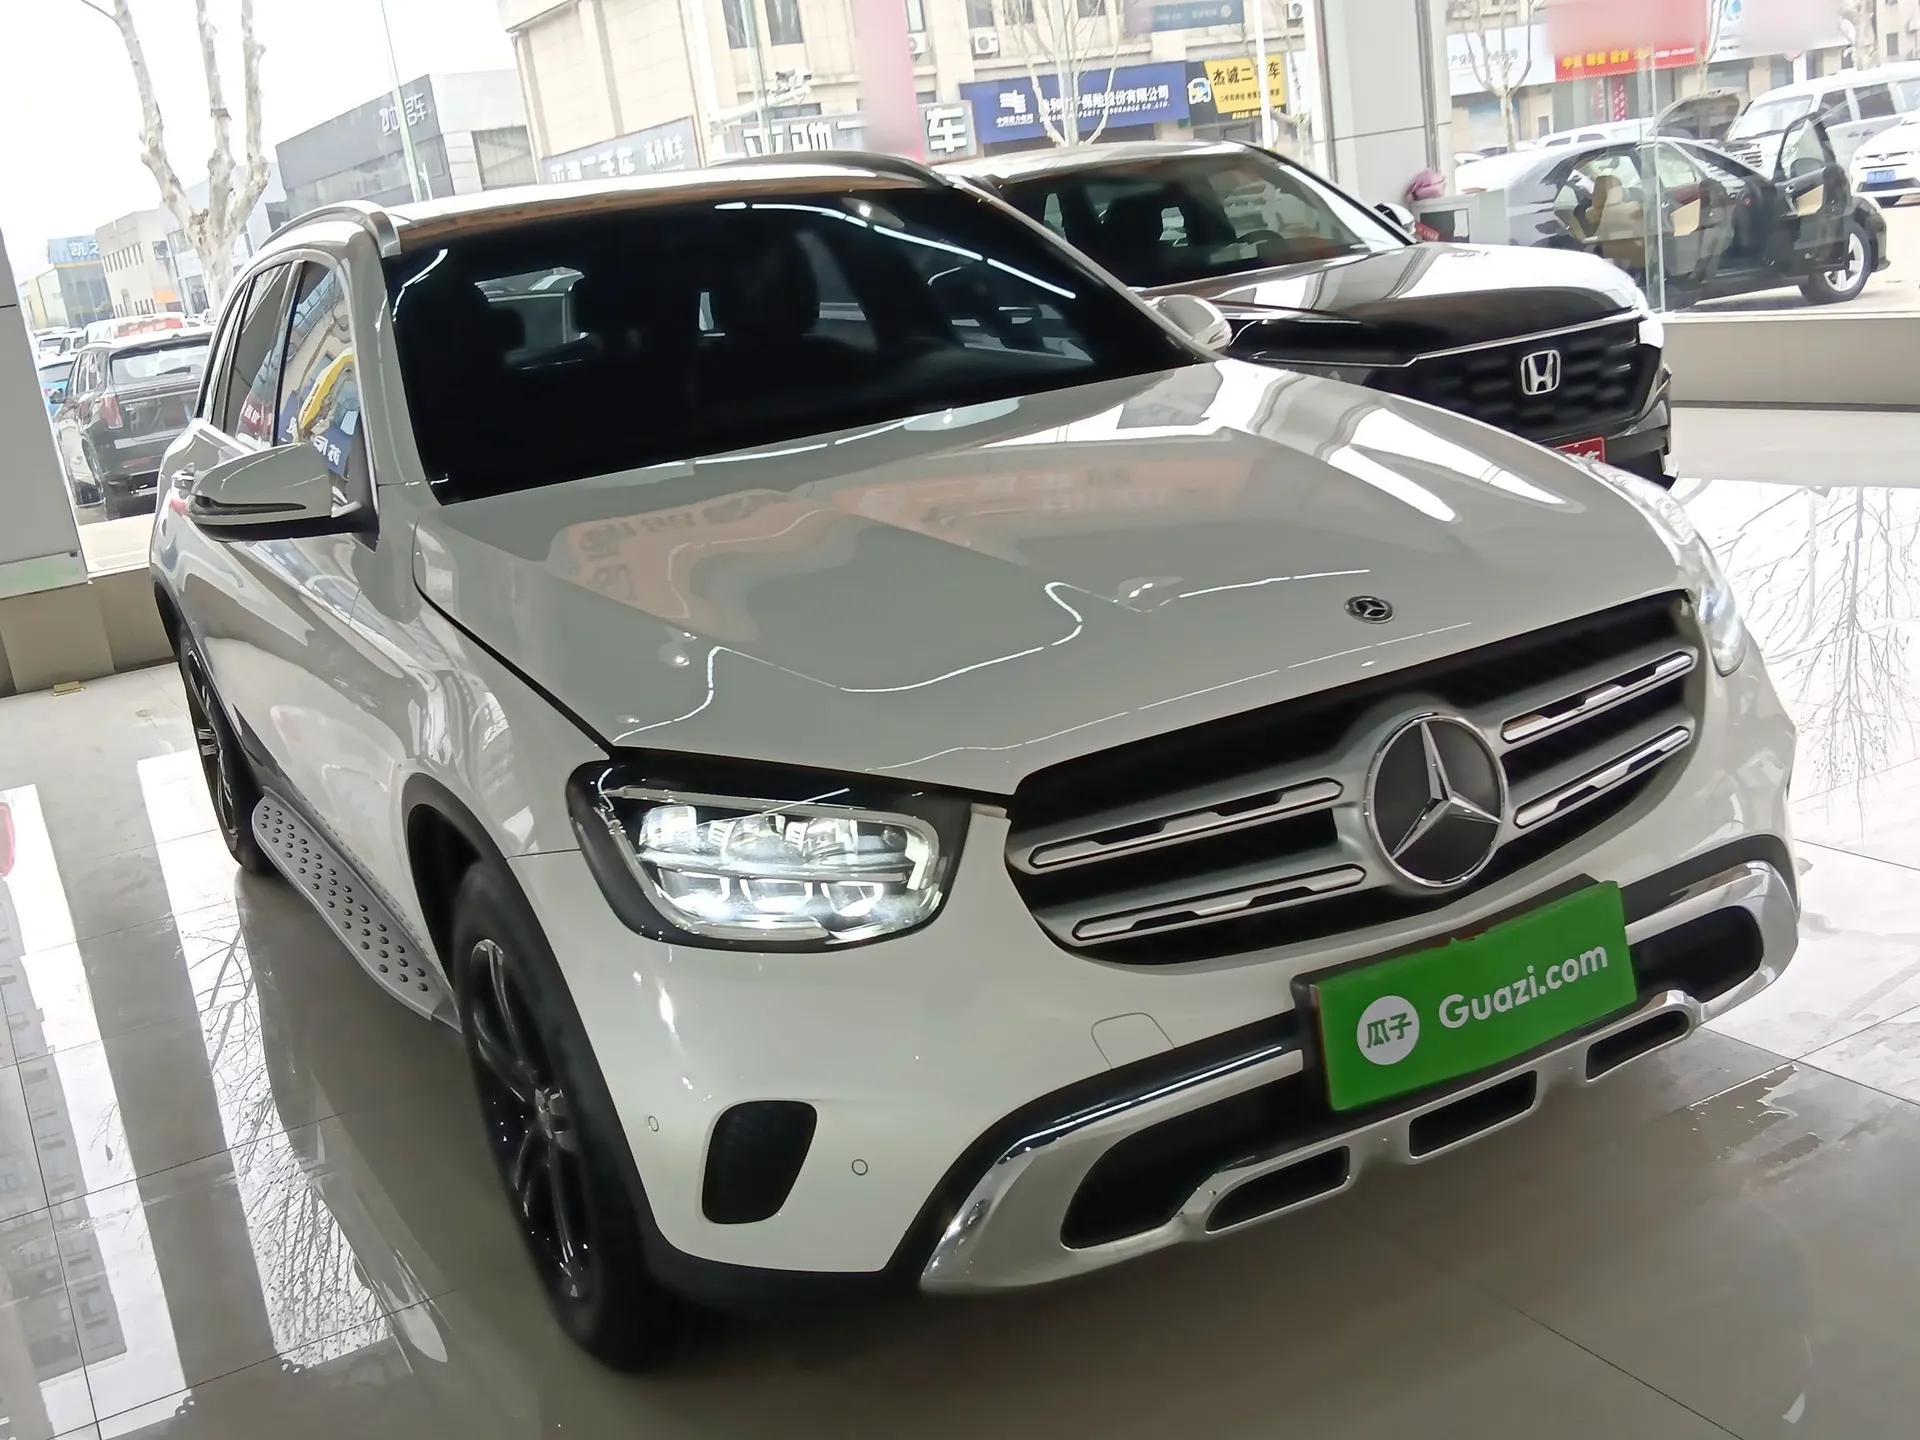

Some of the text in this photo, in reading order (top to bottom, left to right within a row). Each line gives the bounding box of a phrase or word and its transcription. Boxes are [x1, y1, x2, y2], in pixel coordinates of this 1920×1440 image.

[1213, 61, 1281, 86] 杰诚二车
[1439, 946, 1608, 1029] Guazi.com
[1366, 1012, 1412, 1049] 瓜子
